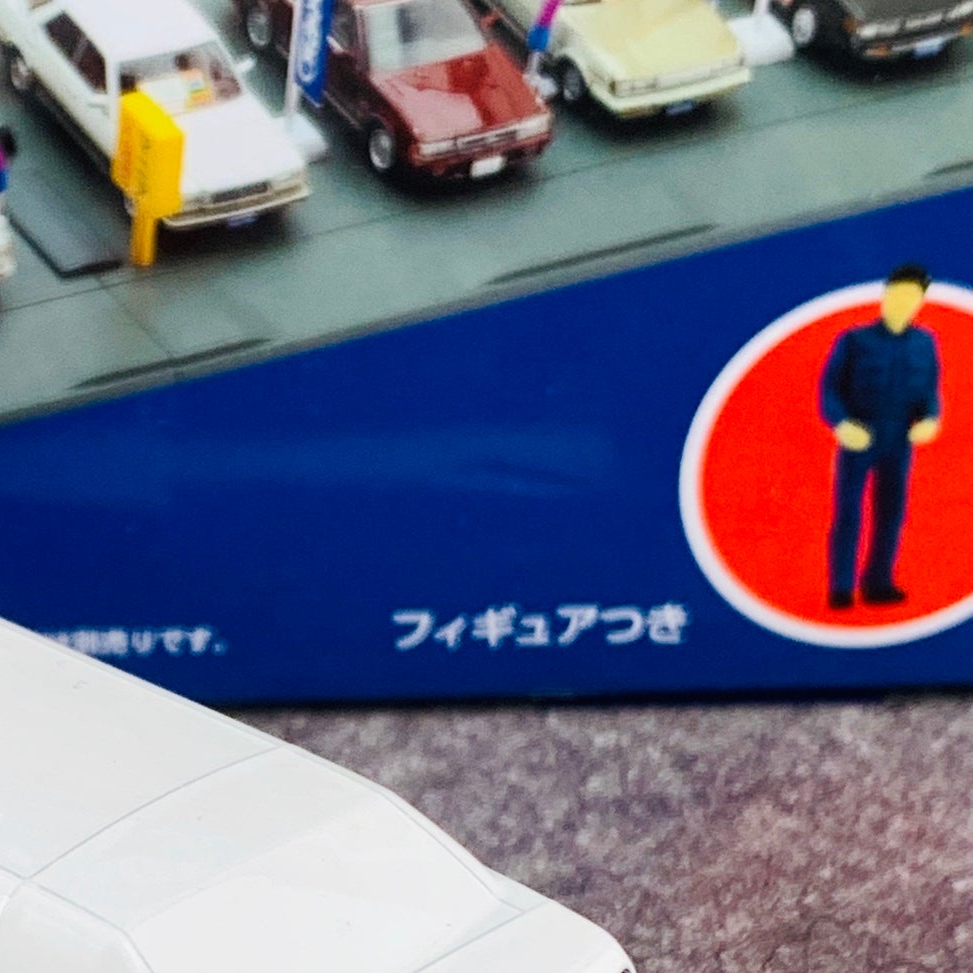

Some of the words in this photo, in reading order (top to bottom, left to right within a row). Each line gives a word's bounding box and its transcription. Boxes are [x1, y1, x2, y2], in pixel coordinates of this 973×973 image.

[392, 602, 687, 649] フィギュアつき
